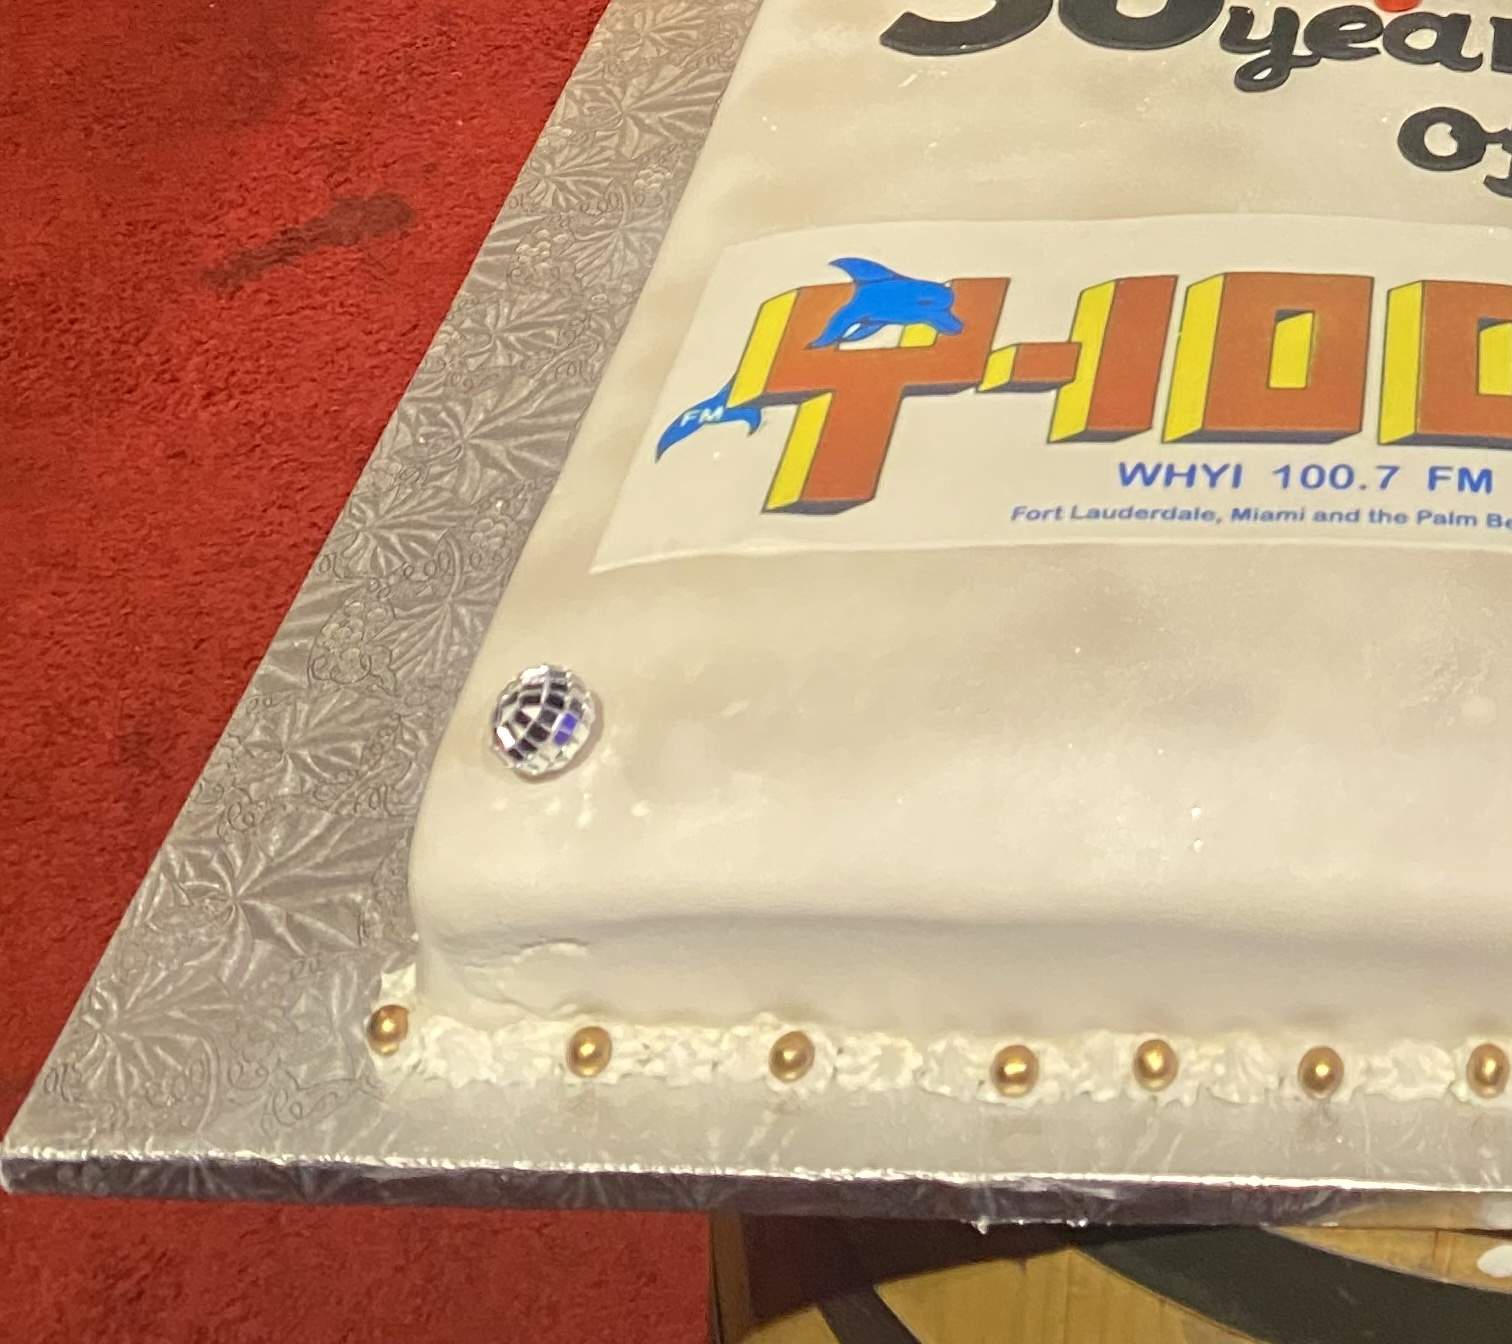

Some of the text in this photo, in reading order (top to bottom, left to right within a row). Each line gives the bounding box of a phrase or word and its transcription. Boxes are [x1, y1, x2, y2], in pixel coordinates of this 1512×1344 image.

[680, 405, 725, 428] FM
[1117, 461, 1494, 495] WHYI 100.7 FM
[1010, 505, 1063, 522] Fort
[1070, 504, 1223, 524] Lauderdale,
[1231, 507, 1305, 523] Miami
[1313, 508, 1360, 524] and
[1369, 508, 1408, 525] the
[1416, 509, 1478, 528] Palm
